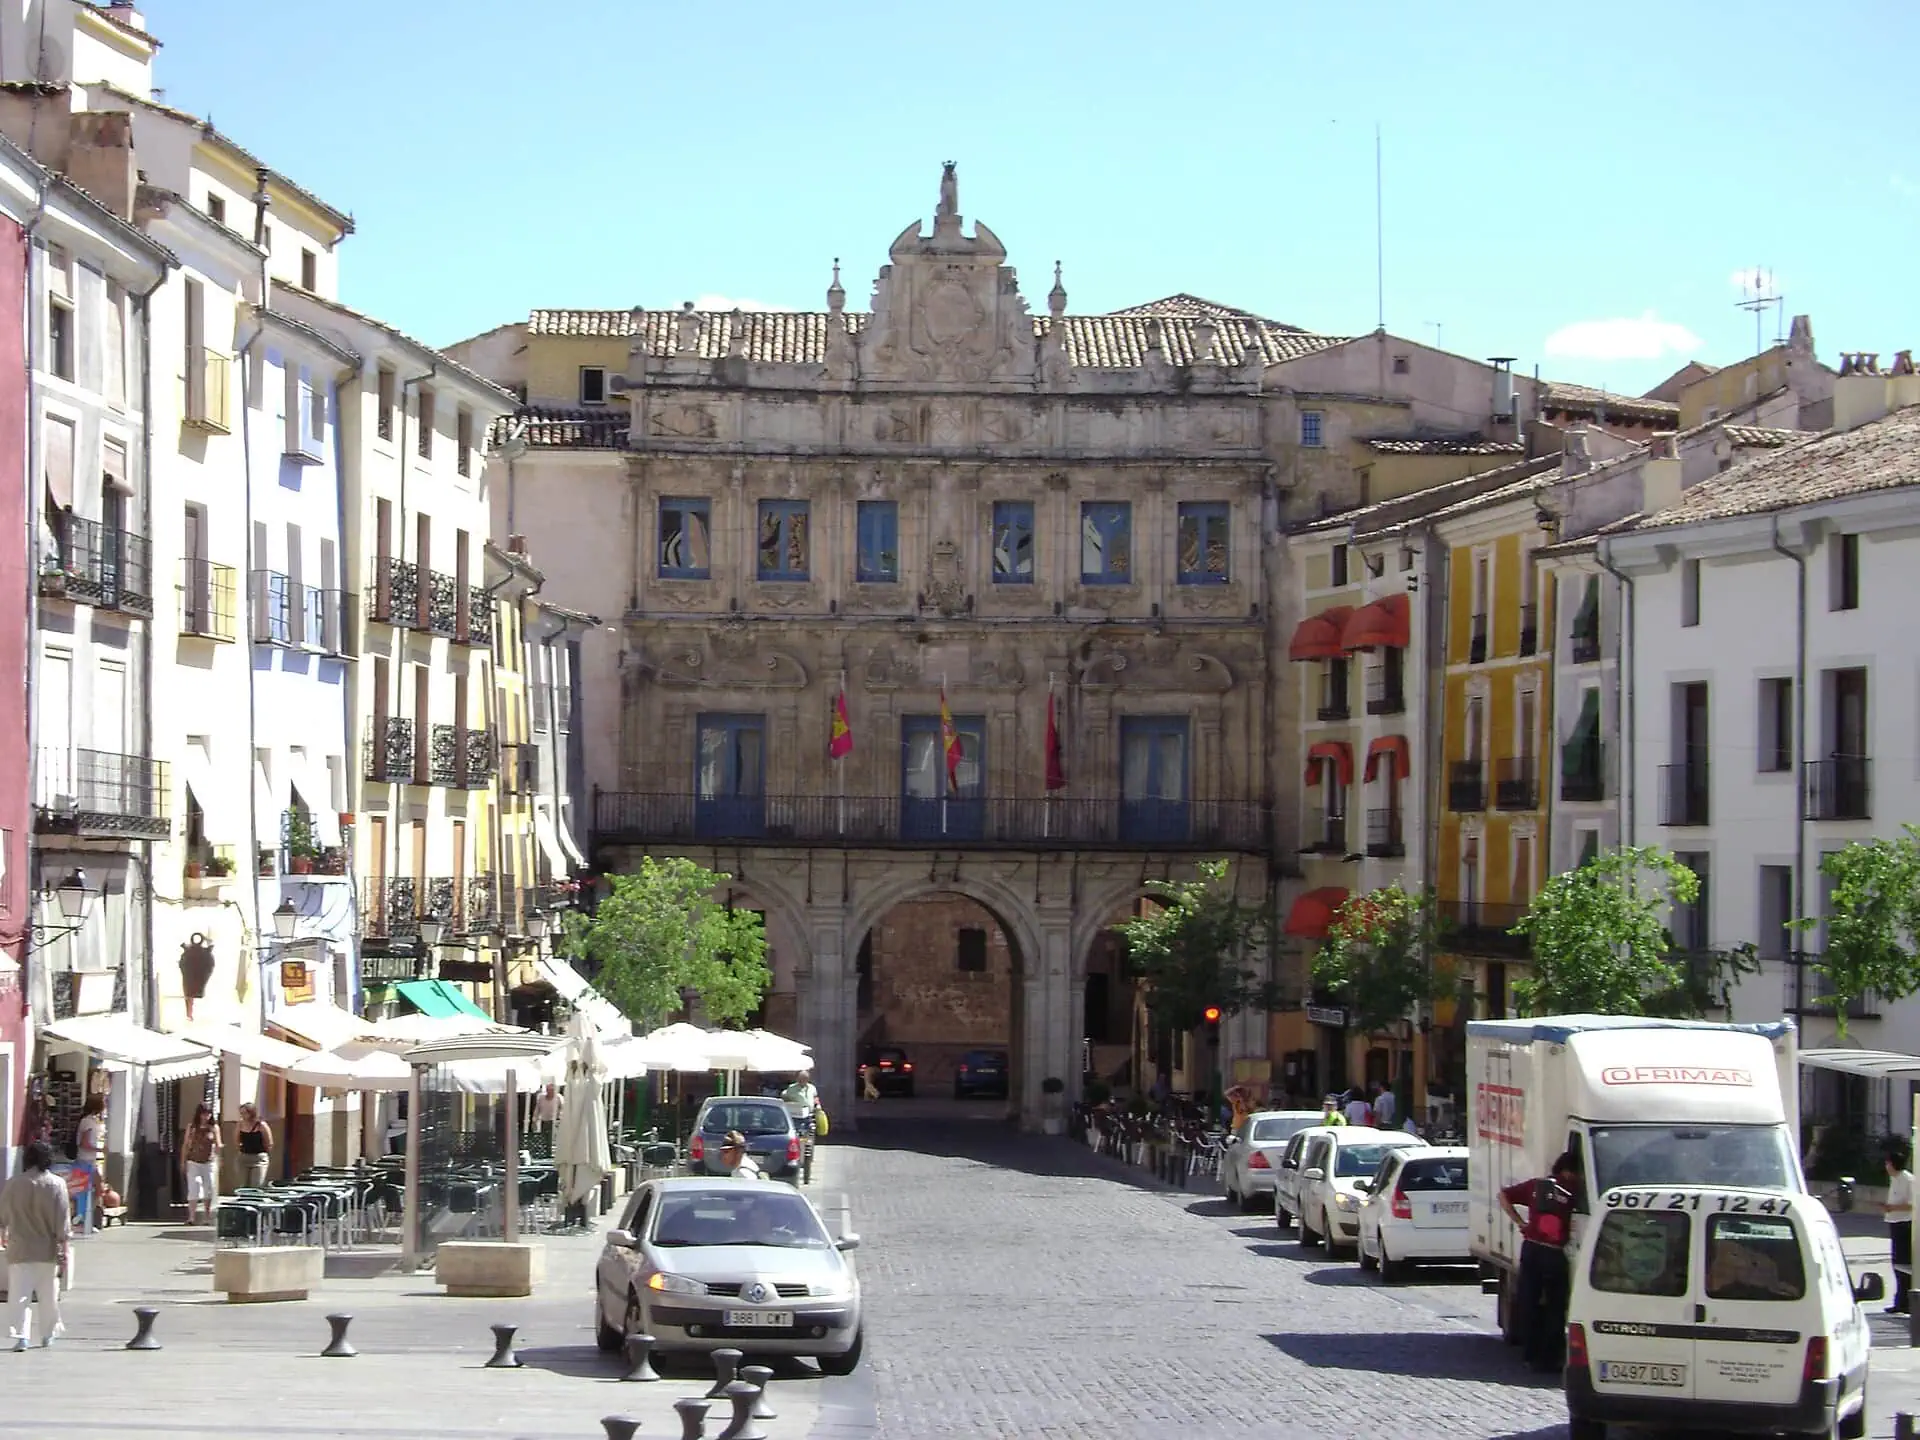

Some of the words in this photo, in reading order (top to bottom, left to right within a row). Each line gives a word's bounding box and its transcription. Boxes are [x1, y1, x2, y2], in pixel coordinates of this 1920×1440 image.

[1607, 1191, 1659, 1209] 967
[1667, 1192, 1703, 1210] 21
[1717, 1195, 1749, 1212] 12
[1759, 1198, 1793, 1216] 47
[1611, 1364, 1647, 1380] 0497
[1651, 1366, 1680, 1382] DLS
